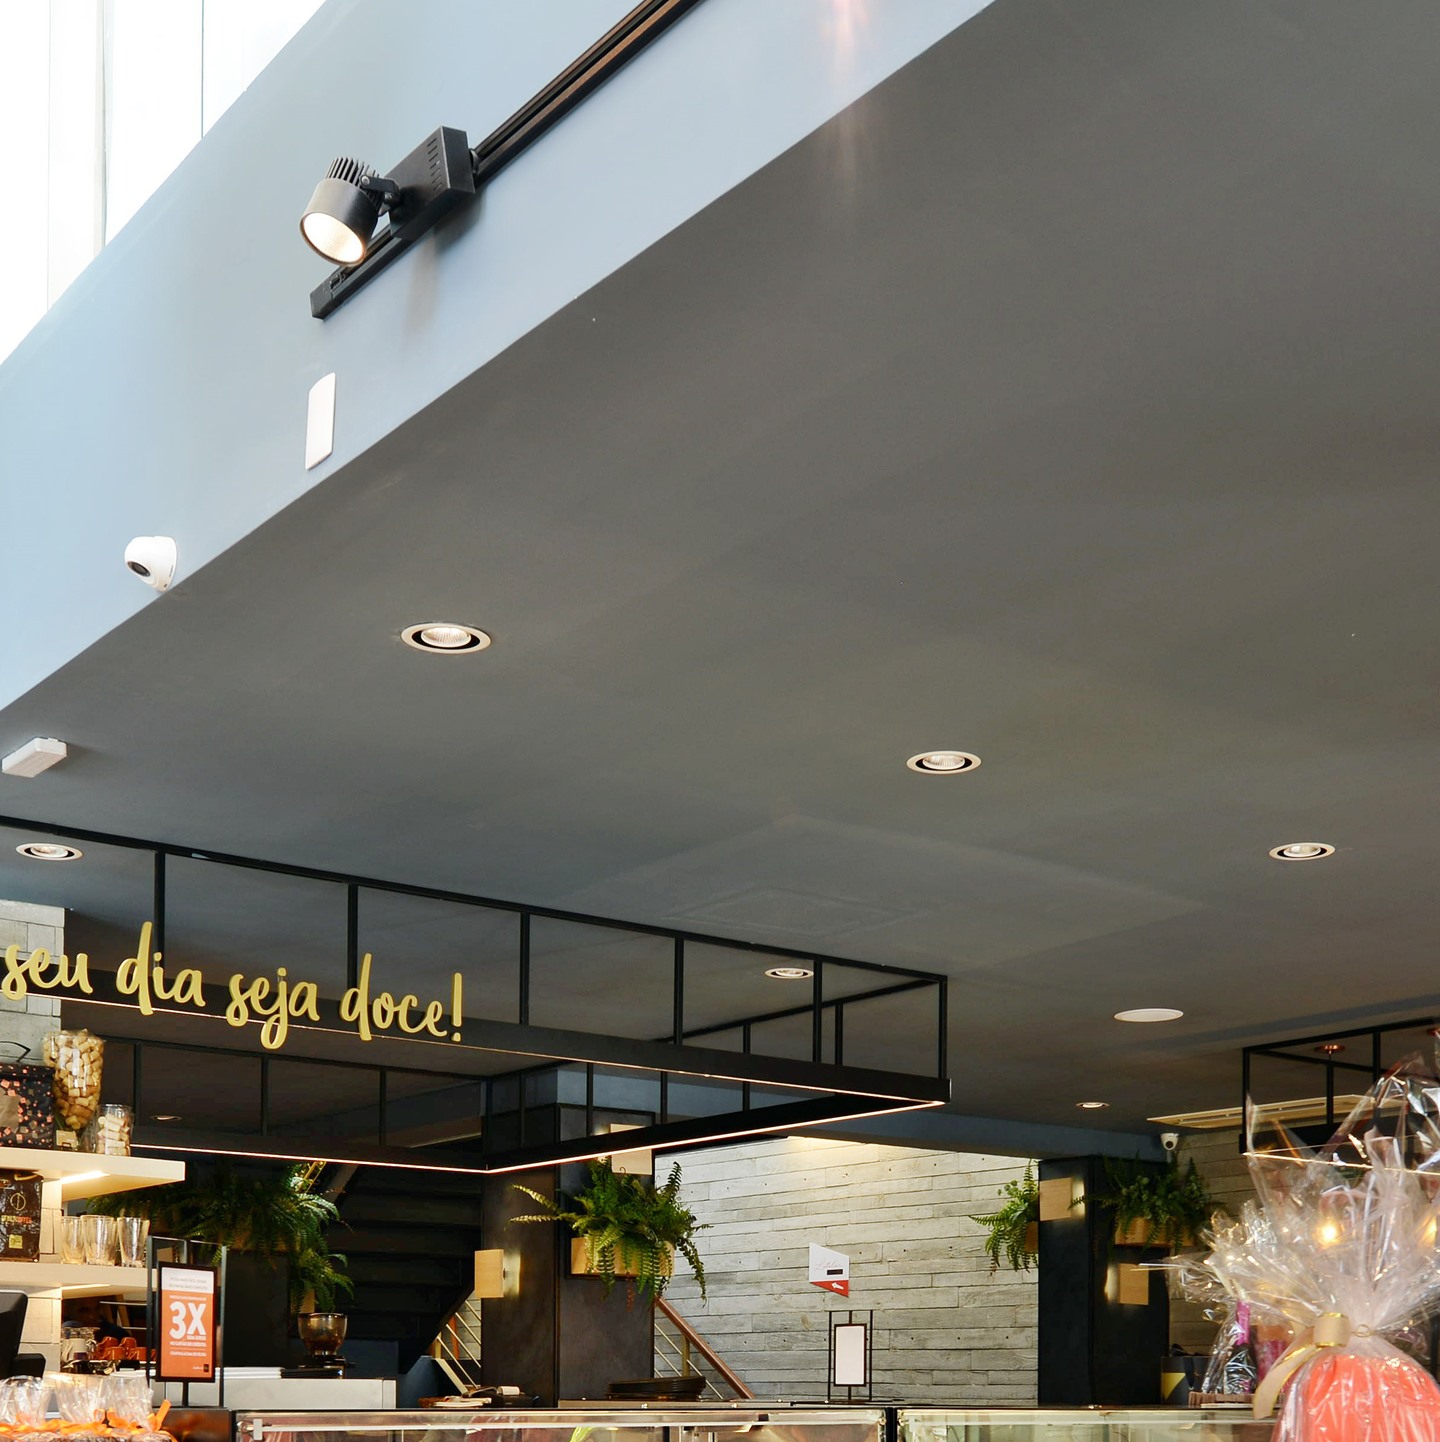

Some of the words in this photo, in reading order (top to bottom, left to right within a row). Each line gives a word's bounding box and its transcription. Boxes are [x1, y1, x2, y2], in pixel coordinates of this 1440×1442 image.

[1, 944, 94, 1001] seu
[116, 921, 206, 1016] dia
[225, 967, 321, 1050] seja
[339, 953, 463, 1042] doce!
[169, 1300, 207, 1340] 3X
